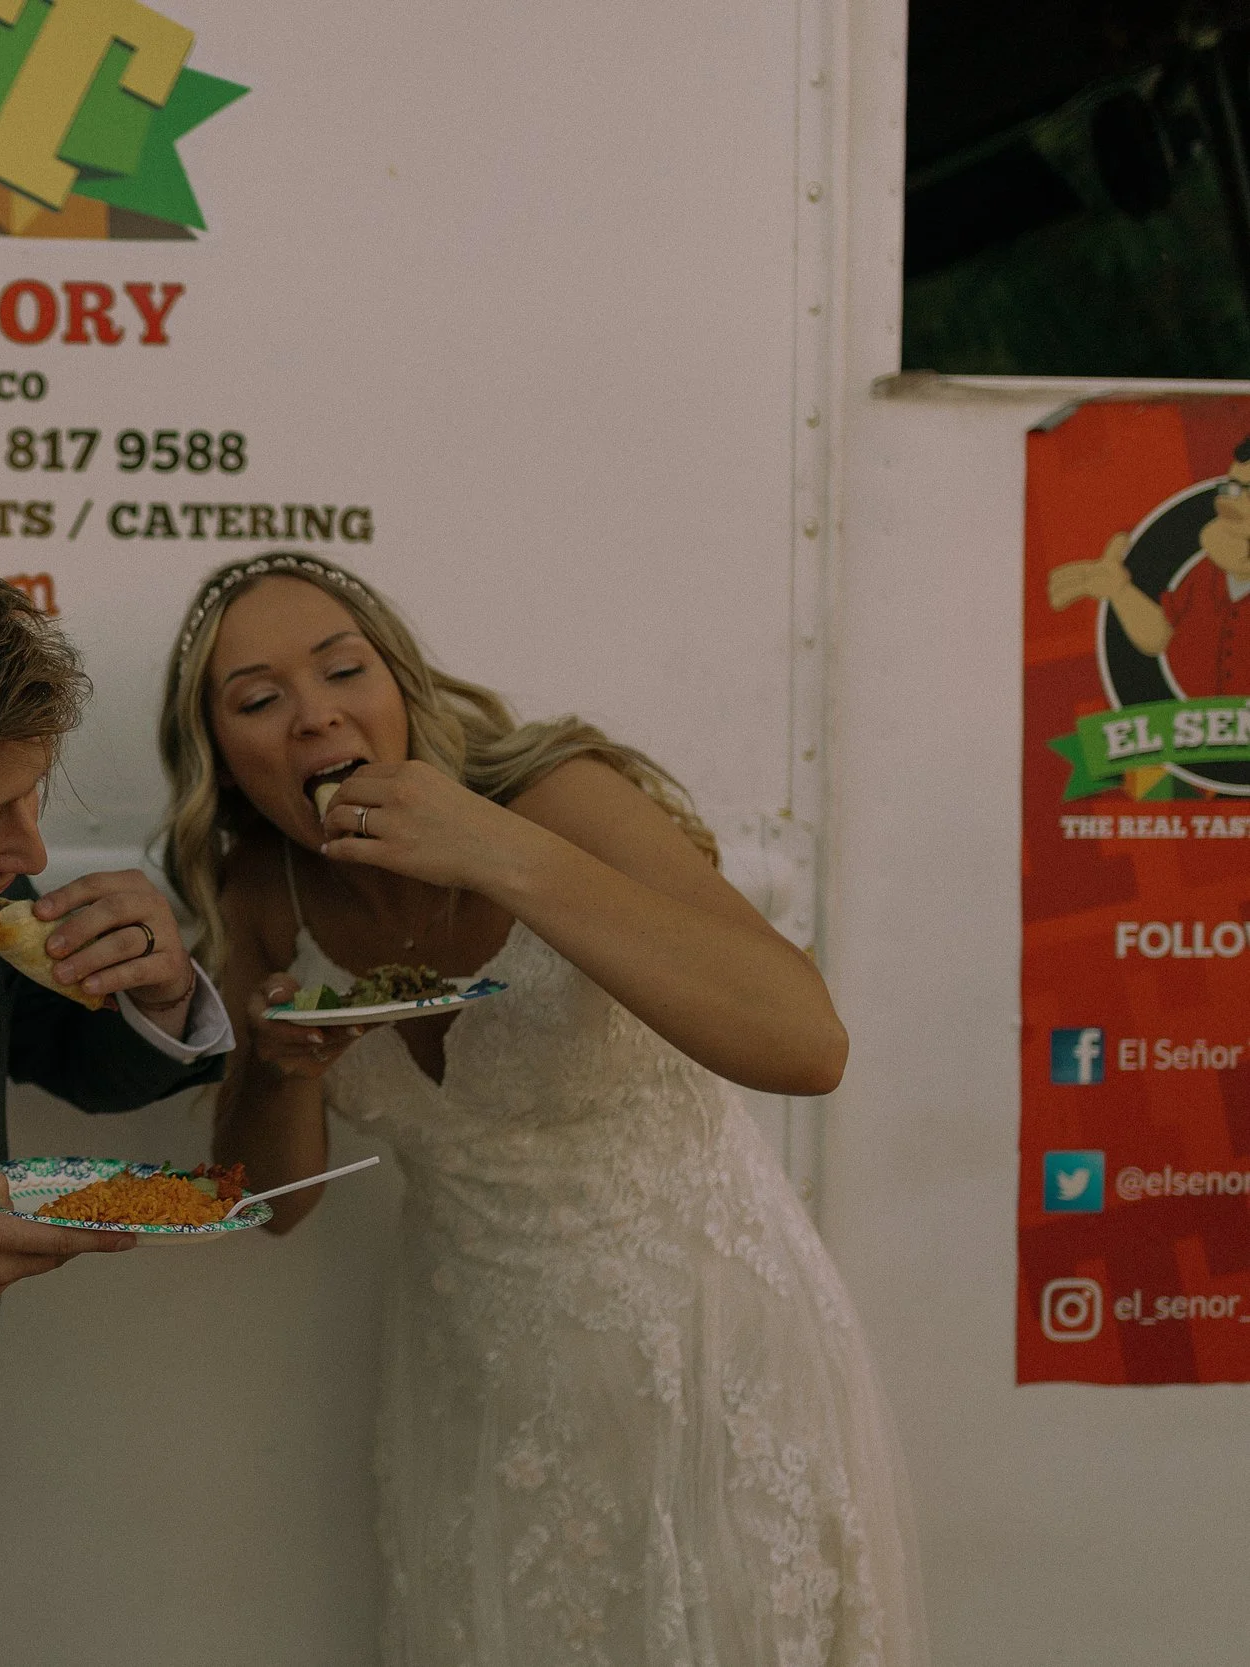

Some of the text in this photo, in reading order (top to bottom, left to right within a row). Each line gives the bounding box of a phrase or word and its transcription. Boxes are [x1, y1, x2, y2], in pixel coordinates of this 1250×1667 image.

[4, 427, 101, 473] 817
[115, 428, 248, 475] 9588
[107, 501, 374, 544] CATERING
[1103, 716, 1164, 762] EL
[1060, 815, 1250, 839] THE REAL TAS
[1115, 921, 1250, 959] FOLLO
[1118, 1038, 1243, 1071] El Señor
